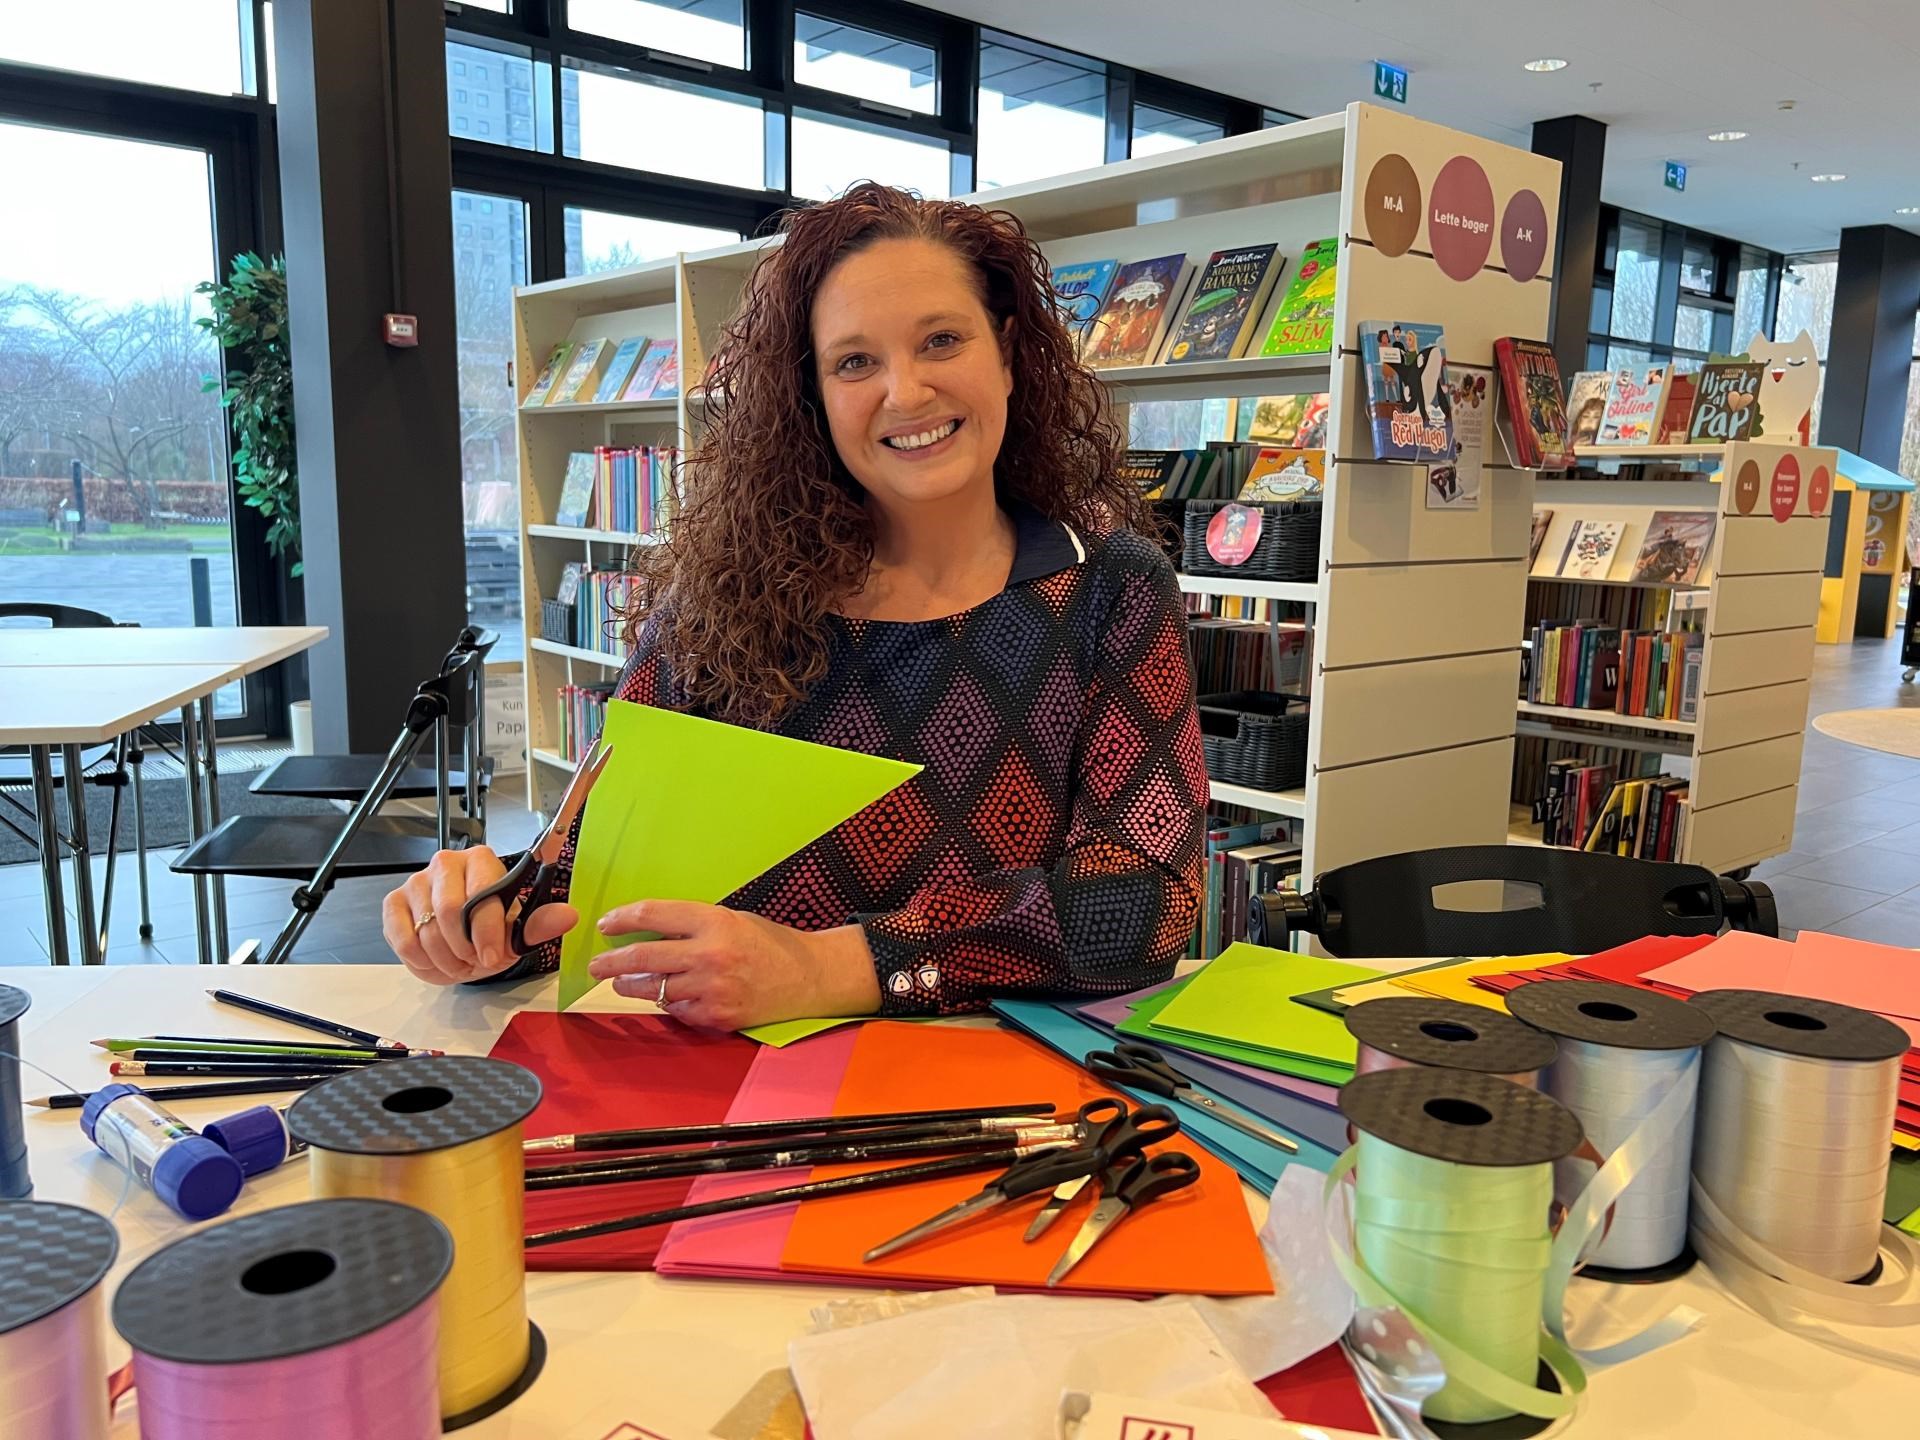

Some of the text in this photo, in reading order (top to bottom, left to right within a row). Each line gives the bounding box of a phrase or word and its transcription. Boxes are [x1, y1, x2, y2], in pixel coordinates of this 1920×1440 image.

[1434, 209, 1489, 234] Lette bøger
[1516, 227, 1533, 242] A-K
[1202, 271, 1260, 289] BANANAS
[1618, 383, 1648, 404] Girl
[1701, 370, 1757, 399] Hjerte
[1607, 400, 1654, 418] Online
[1712, 392, 1726, 408] af
[1393, 411, 1423, 425] Operation
[1691, 404, 1749, 439] Pap
[1392, 422, 1413, 445] Red
[1415, 423, 1447, 452] Hugo!
[1605, 667, 1618, 688] W
[502, 700, 523, 711] Kun
[1553, 797, 1563, 818] Z
